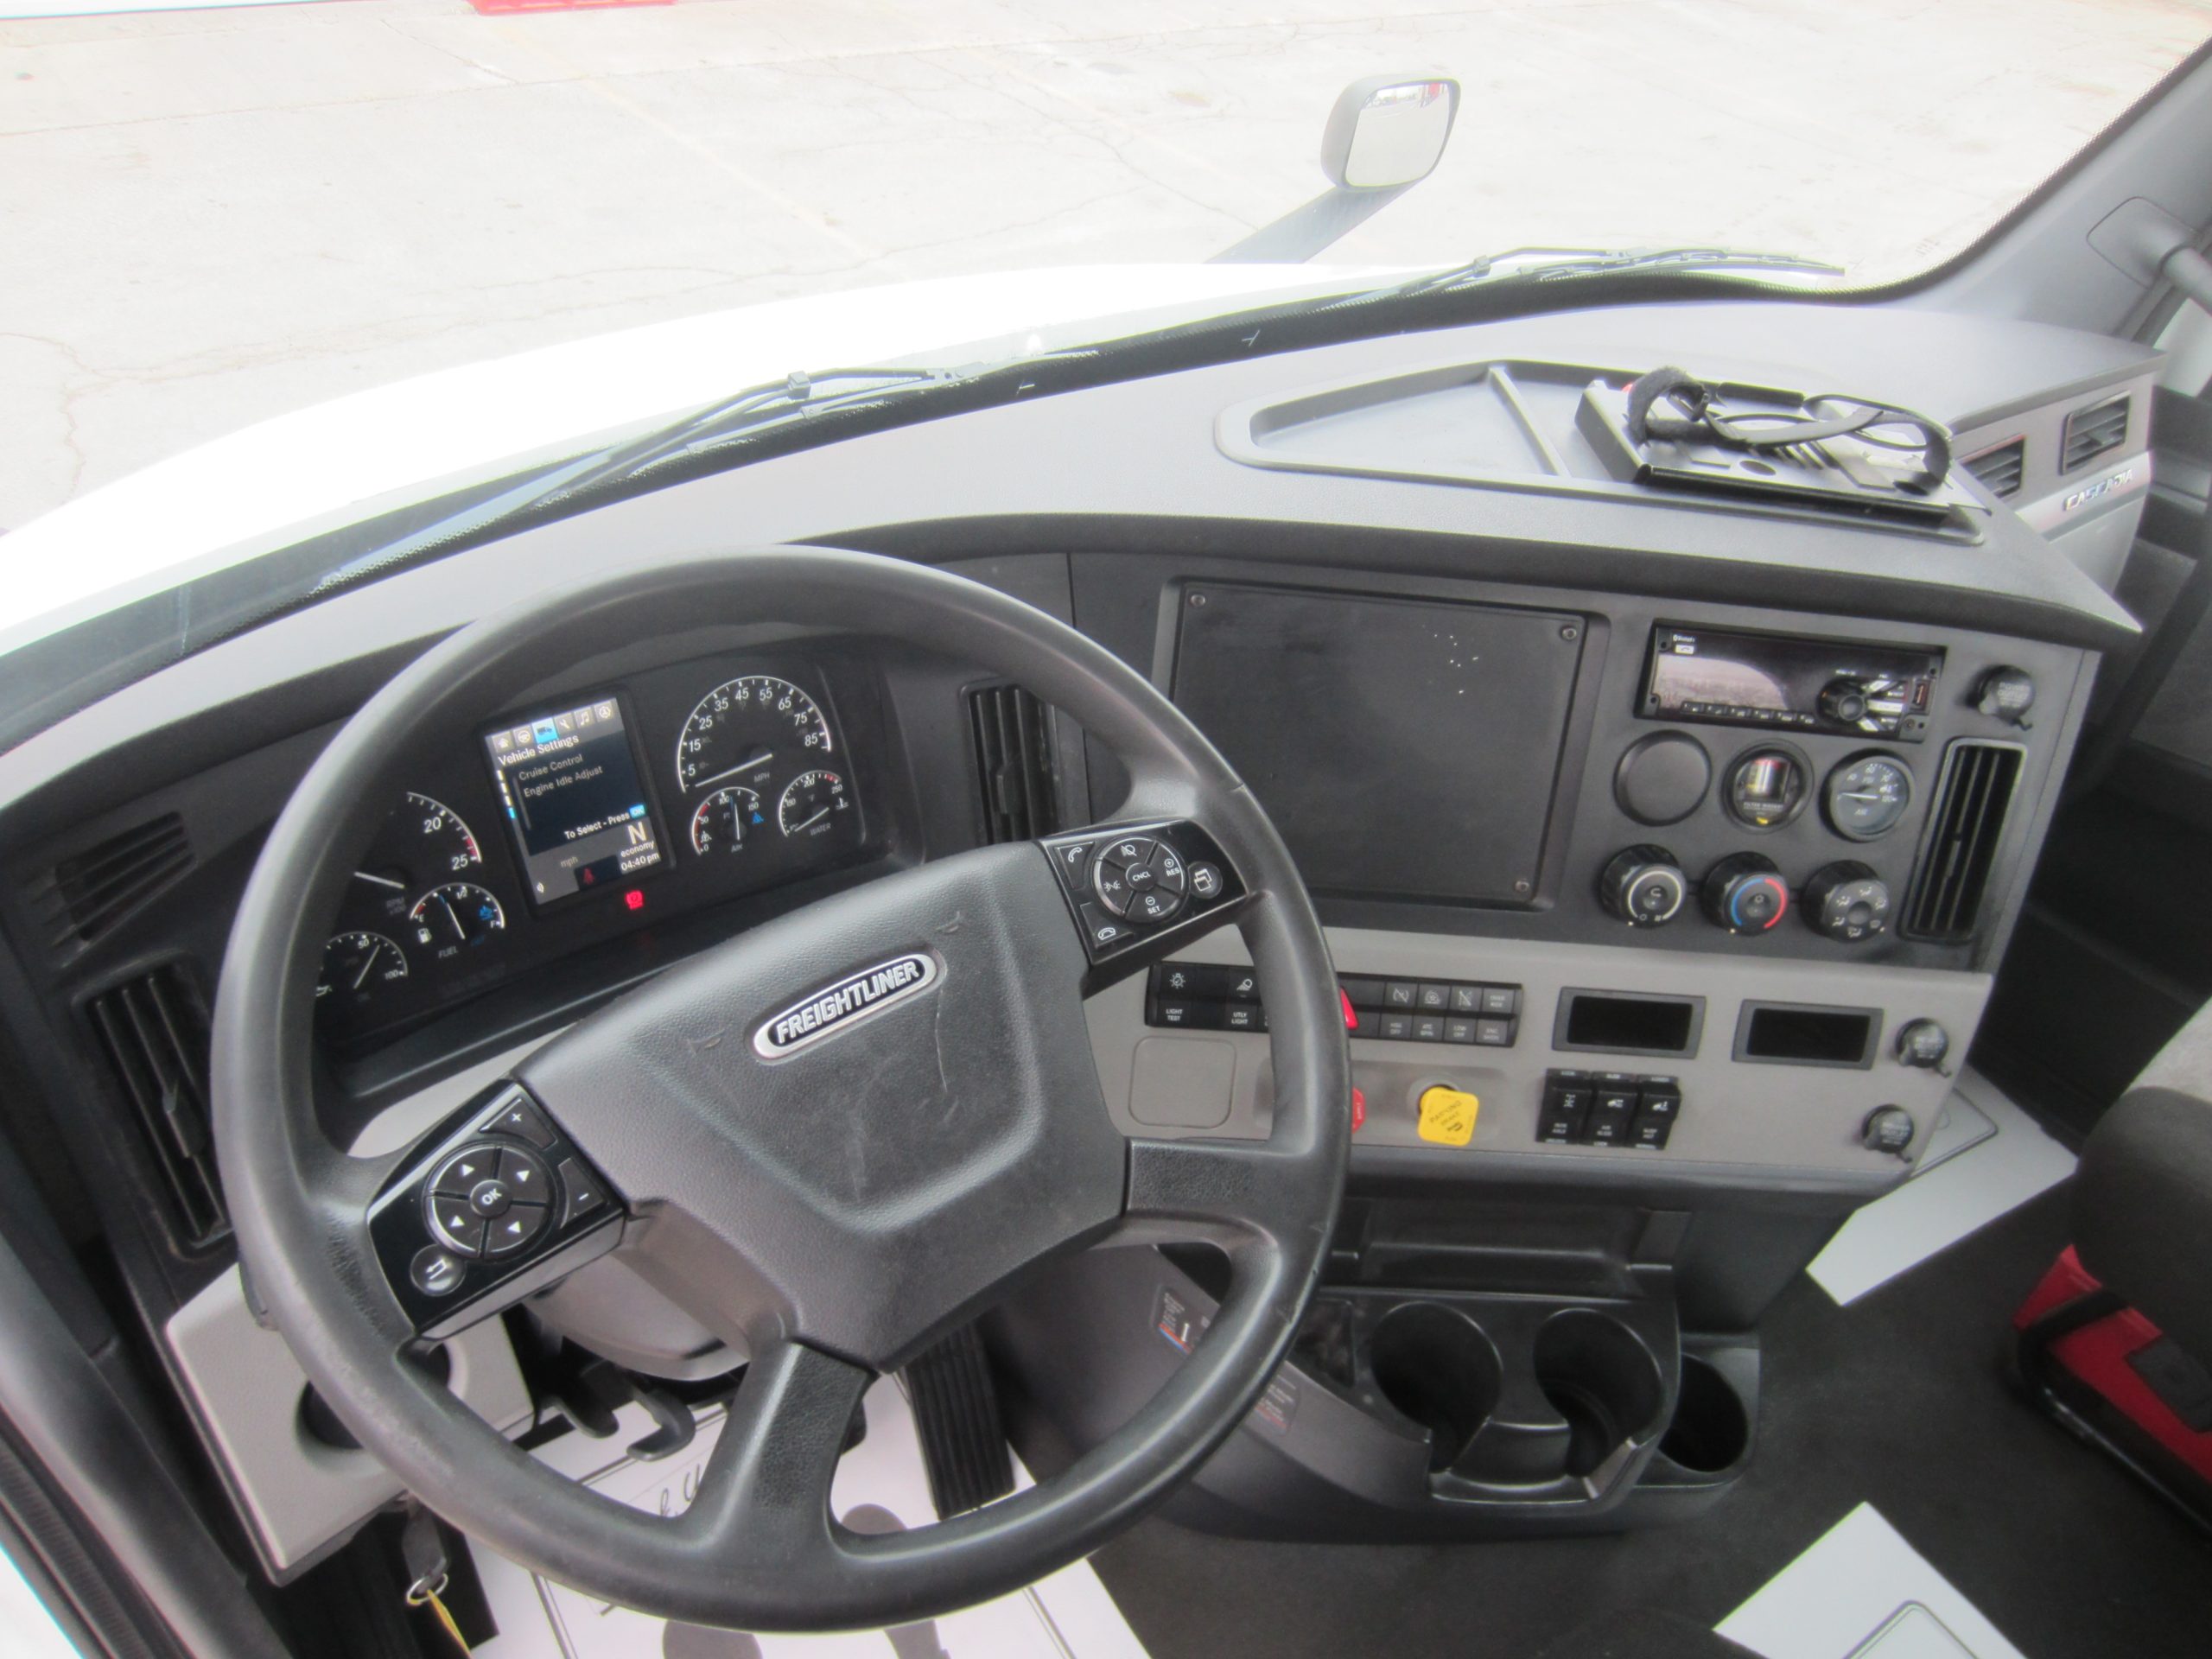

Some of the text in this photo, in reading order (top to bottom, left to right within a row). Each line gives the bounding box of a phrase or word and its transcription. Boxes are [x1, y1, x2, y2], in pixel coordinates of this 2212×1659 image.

[734, 687, 749, 701] 45
[760, 687, 772, 702] 55
[715, 698, 728, 712] 35
[779, 696, 791, 710] 65
[699, 716, 713, 730] 25
[794, 712, 808, 726] 75
[689, 740, 701, 753] 15
[804, 733, 818, 747] 85
[498, 734, 580, 766] Vehicle Settings
[518, 754, 583, 780] Cruise Control
[688, 764, 696, 776] 5
[524, 766, 603, 798] Engine Idle Adjust
[423, 817, 442, 834] 20
[564, 830, 575, 840] To
[576, 821, 601, 836] Select
[607, 812, 630, 825] Press
[627, 822, 648, 845] N
[620, 840, 655, 858] economy
[451, 854, 468, 871] 25
[620, 852, 660, 871] 04:40 pm
[1132, 871, 1151, 882] CNCL
[1166, 868, 1180, 877] RES
[1147, 905, 1161, 915] SET
[438, 945, 458, 958] FUEL
[776, 961, 920, 1045] FREIGHTLINER
[481, 1188, 501, 1205] OK
